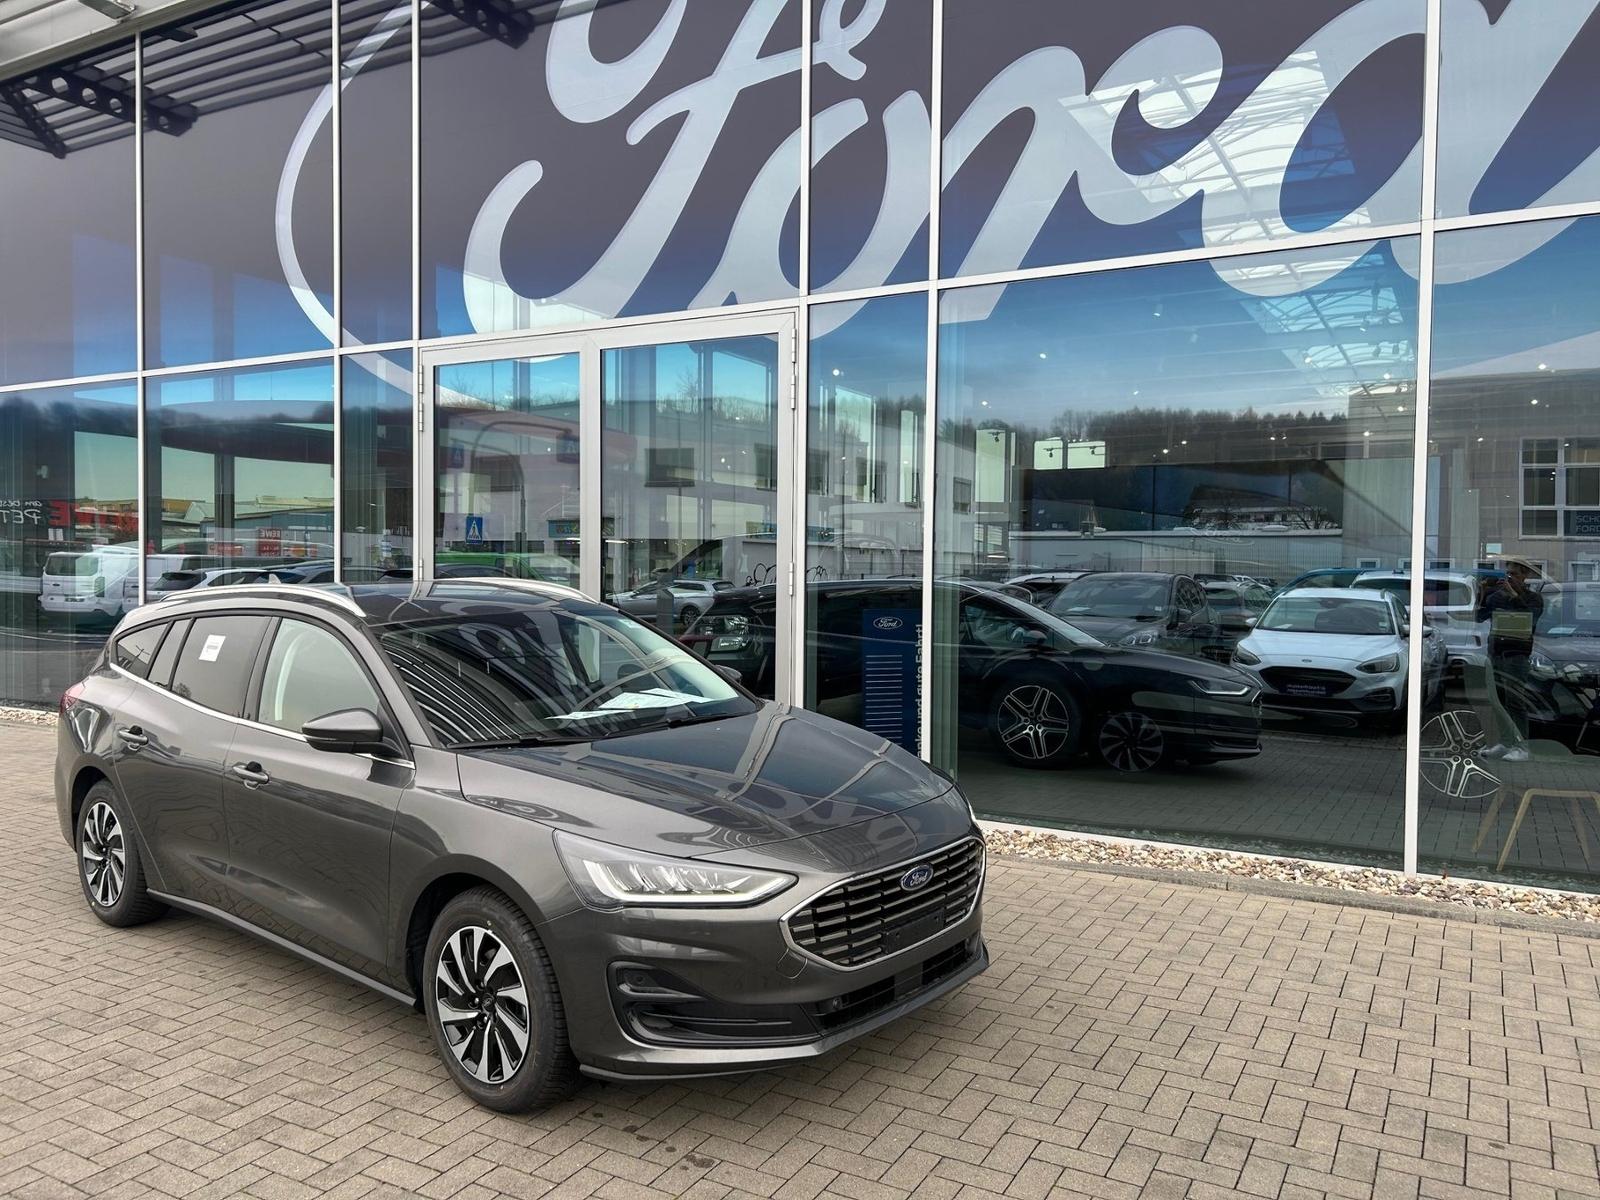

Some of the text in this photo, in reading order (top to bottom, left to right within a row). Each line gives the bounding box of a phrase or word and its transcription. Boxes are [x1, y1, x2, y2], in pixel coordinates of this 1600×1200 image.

[464, 0, 1600, 363] Ford
[877, 617, 899, 628] Ford
[909, 870, 929, 887] Ford
